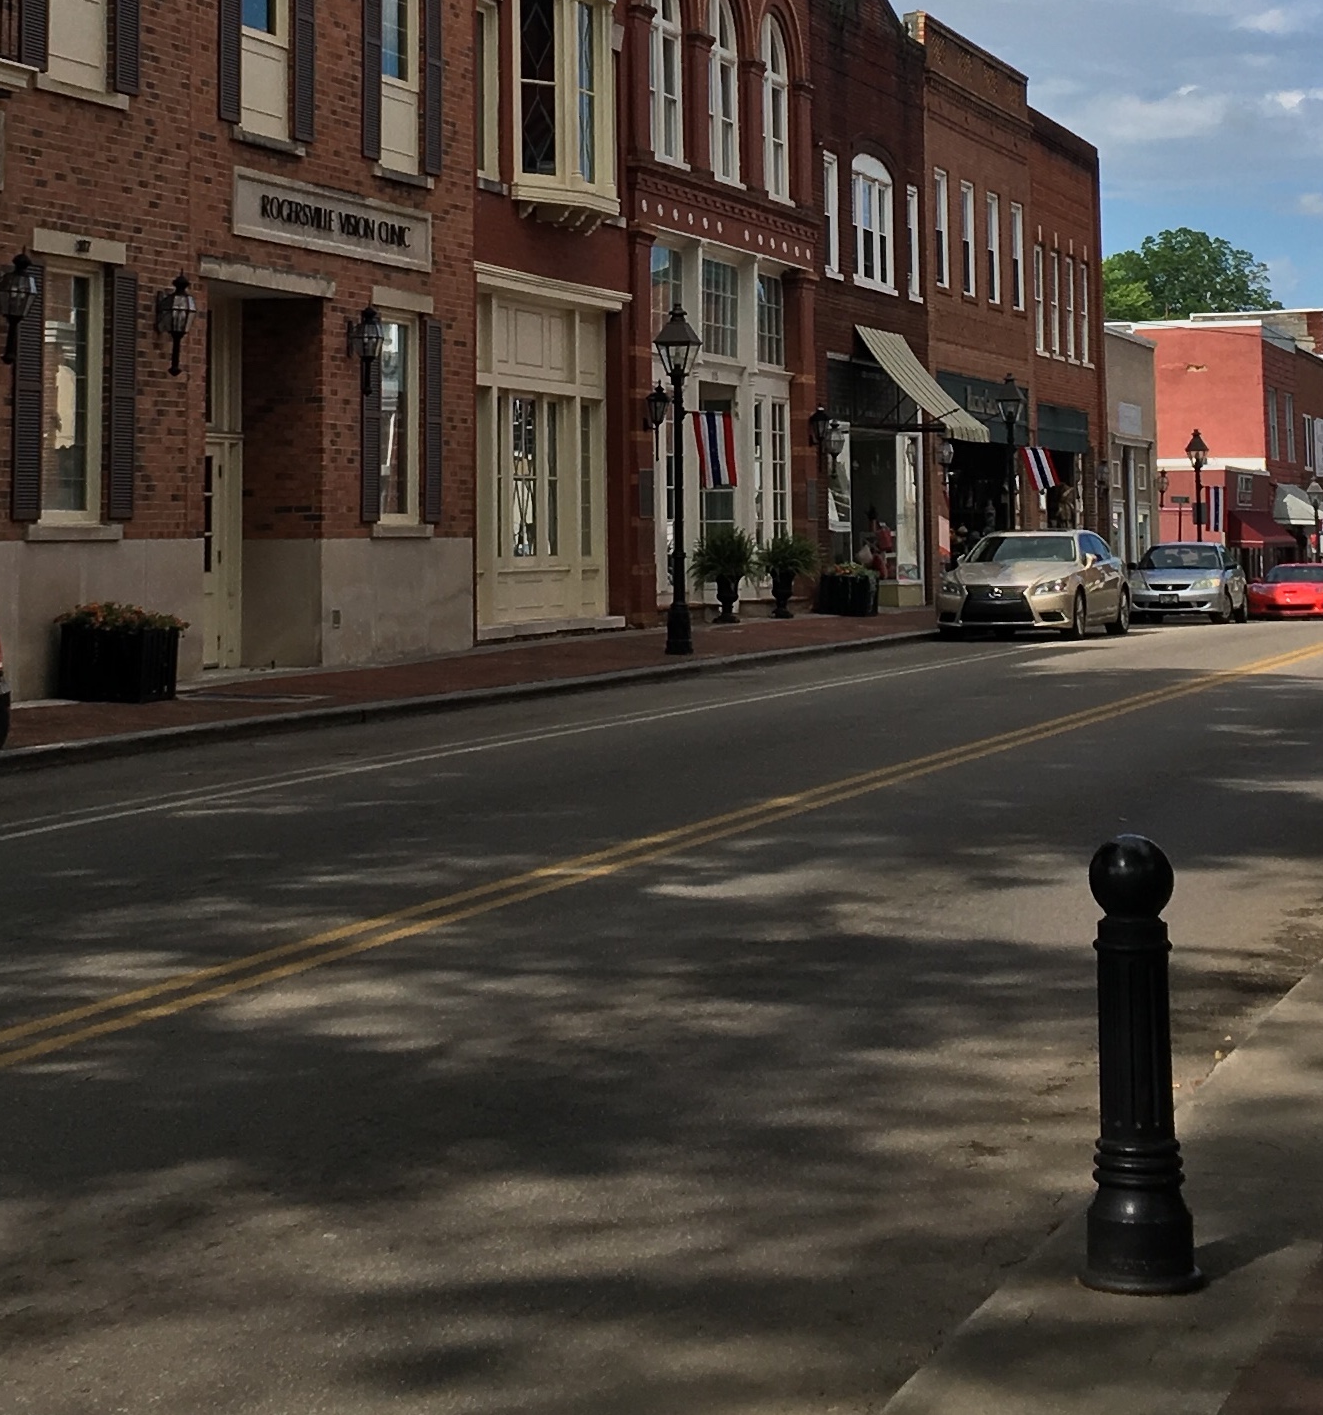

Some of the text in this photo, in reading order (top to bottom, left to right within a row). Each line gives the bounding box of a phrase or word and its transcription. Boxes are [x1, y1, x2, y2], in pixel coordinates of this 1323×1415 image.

[261, 194, 411, 248] ROGERSVILLE VISION CLINIC
